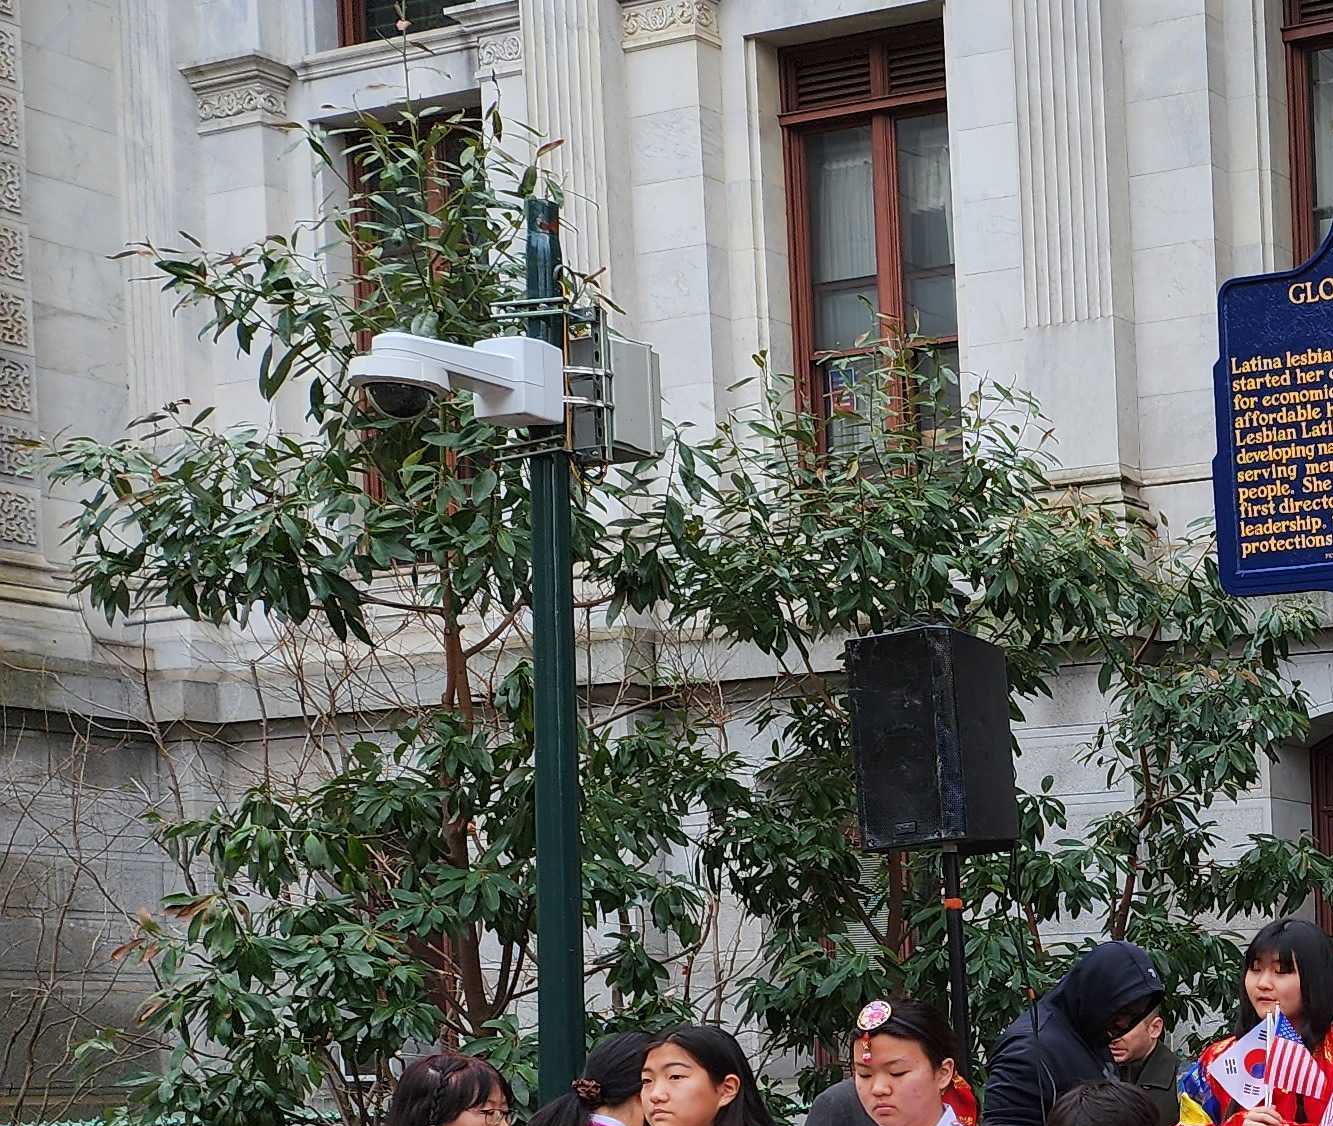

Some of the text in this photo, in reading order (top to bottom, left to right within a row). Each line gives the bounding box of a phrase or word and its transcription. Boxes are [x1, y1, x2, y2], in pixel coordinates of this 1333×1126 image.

[1230, 355, 1283, 375] Latina
[1232, 369, 1291, 392] started
[1295, 368, 1325, 385] her
[1233, 394, 1259, 411] for
[1234, 403, 1323, 429] affordable
[1234, 426, 1297, 447] Lesbian
[1236, 442, 1316, 465] developing
[1237, 461, 1298, 483] serving
[1237, 478, 1295, 504] people.
[1302, 476, 1332, 493] She
[1238, 497, 1277, 518] first
[1241, 532, 1333, 558] protections
